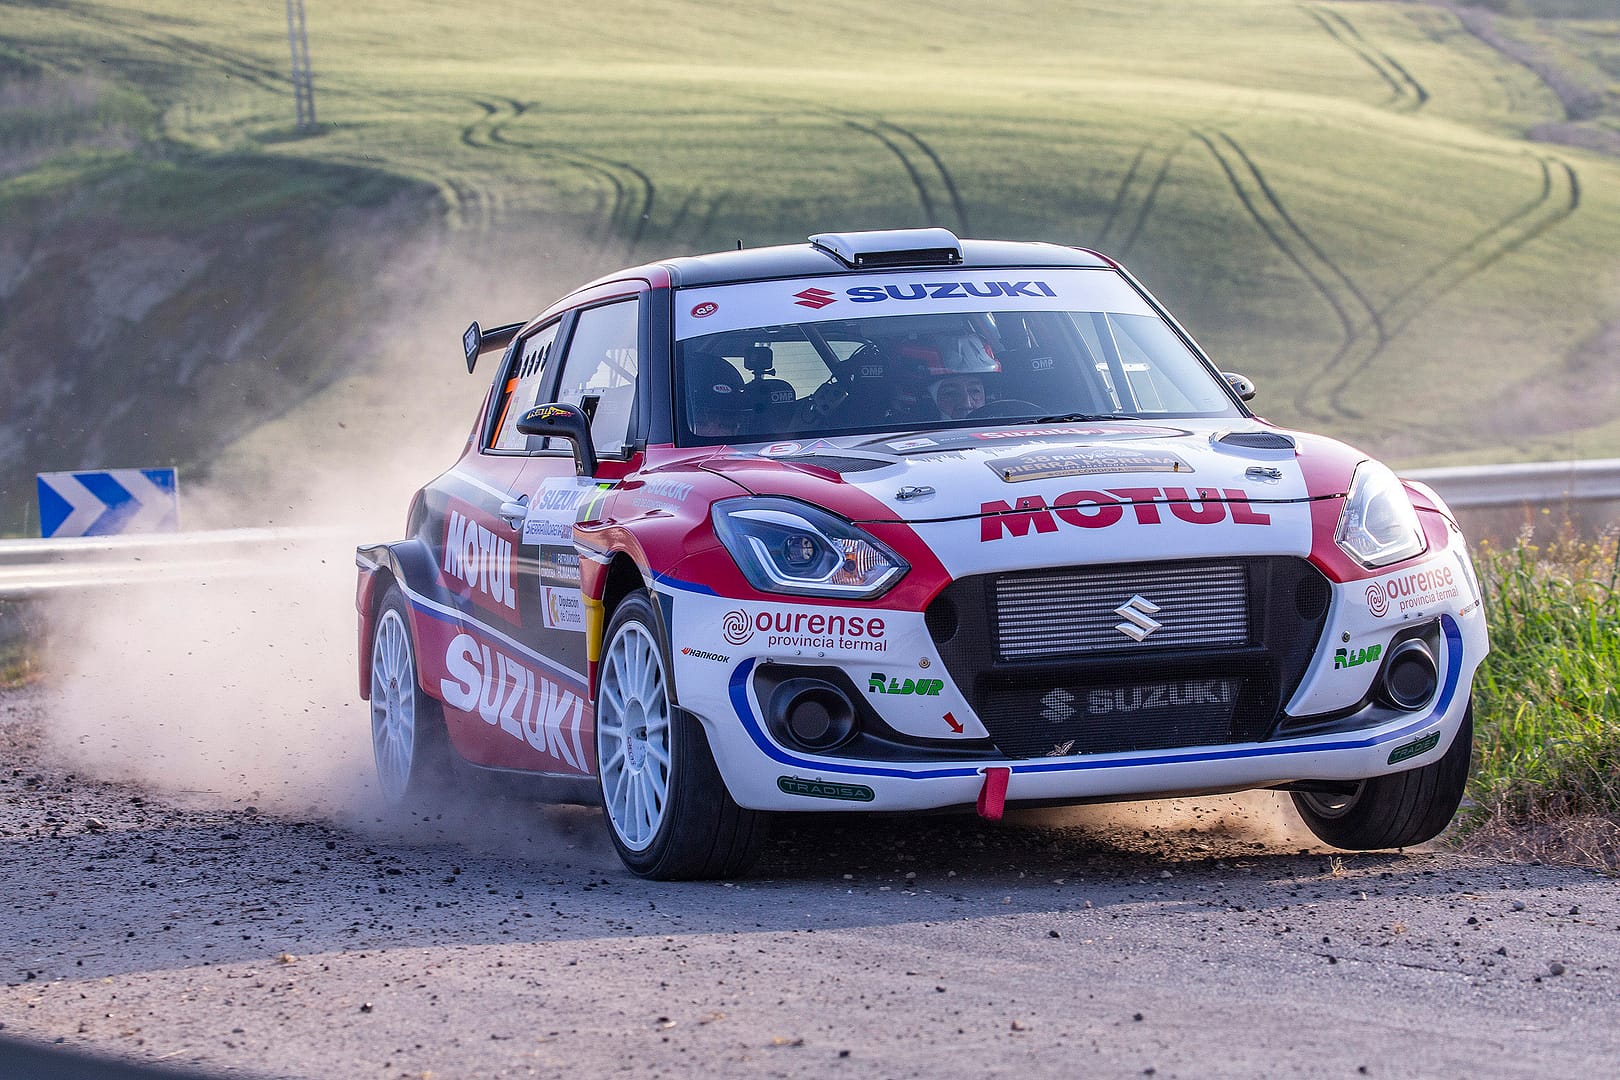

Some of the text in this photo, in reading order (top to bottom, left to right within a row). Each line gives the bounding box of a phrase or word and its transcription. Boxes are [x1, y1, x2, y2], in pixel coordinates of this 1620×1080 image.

[845, 281, 1058, 303] SUZUKI
[861, 367, 884, 376] OMP
[1032, 359, 1054, 370] OMP
[771, 392, 794, 402] OMP
[648, 481, 695, 502] SUZUKI
[980, 487, 1271, 543] MOTUL
[444, 510, 517, 610] MOTUL
[1386, 565, 1454, 600] ourense
[1400, 586, 1459, 613] provincia termal
[732, 623, 744, 631] OU
[755, 611, 885, 638] ourense
[768, 634, 887, 652] provincia termal
[868, 672, 944, 696] REDUR
[440, 633, 590, 774] SUZUKI
[1087, 679, 1231, 714] SUZUKI
[783, 780, 867, 798] TRADISA
